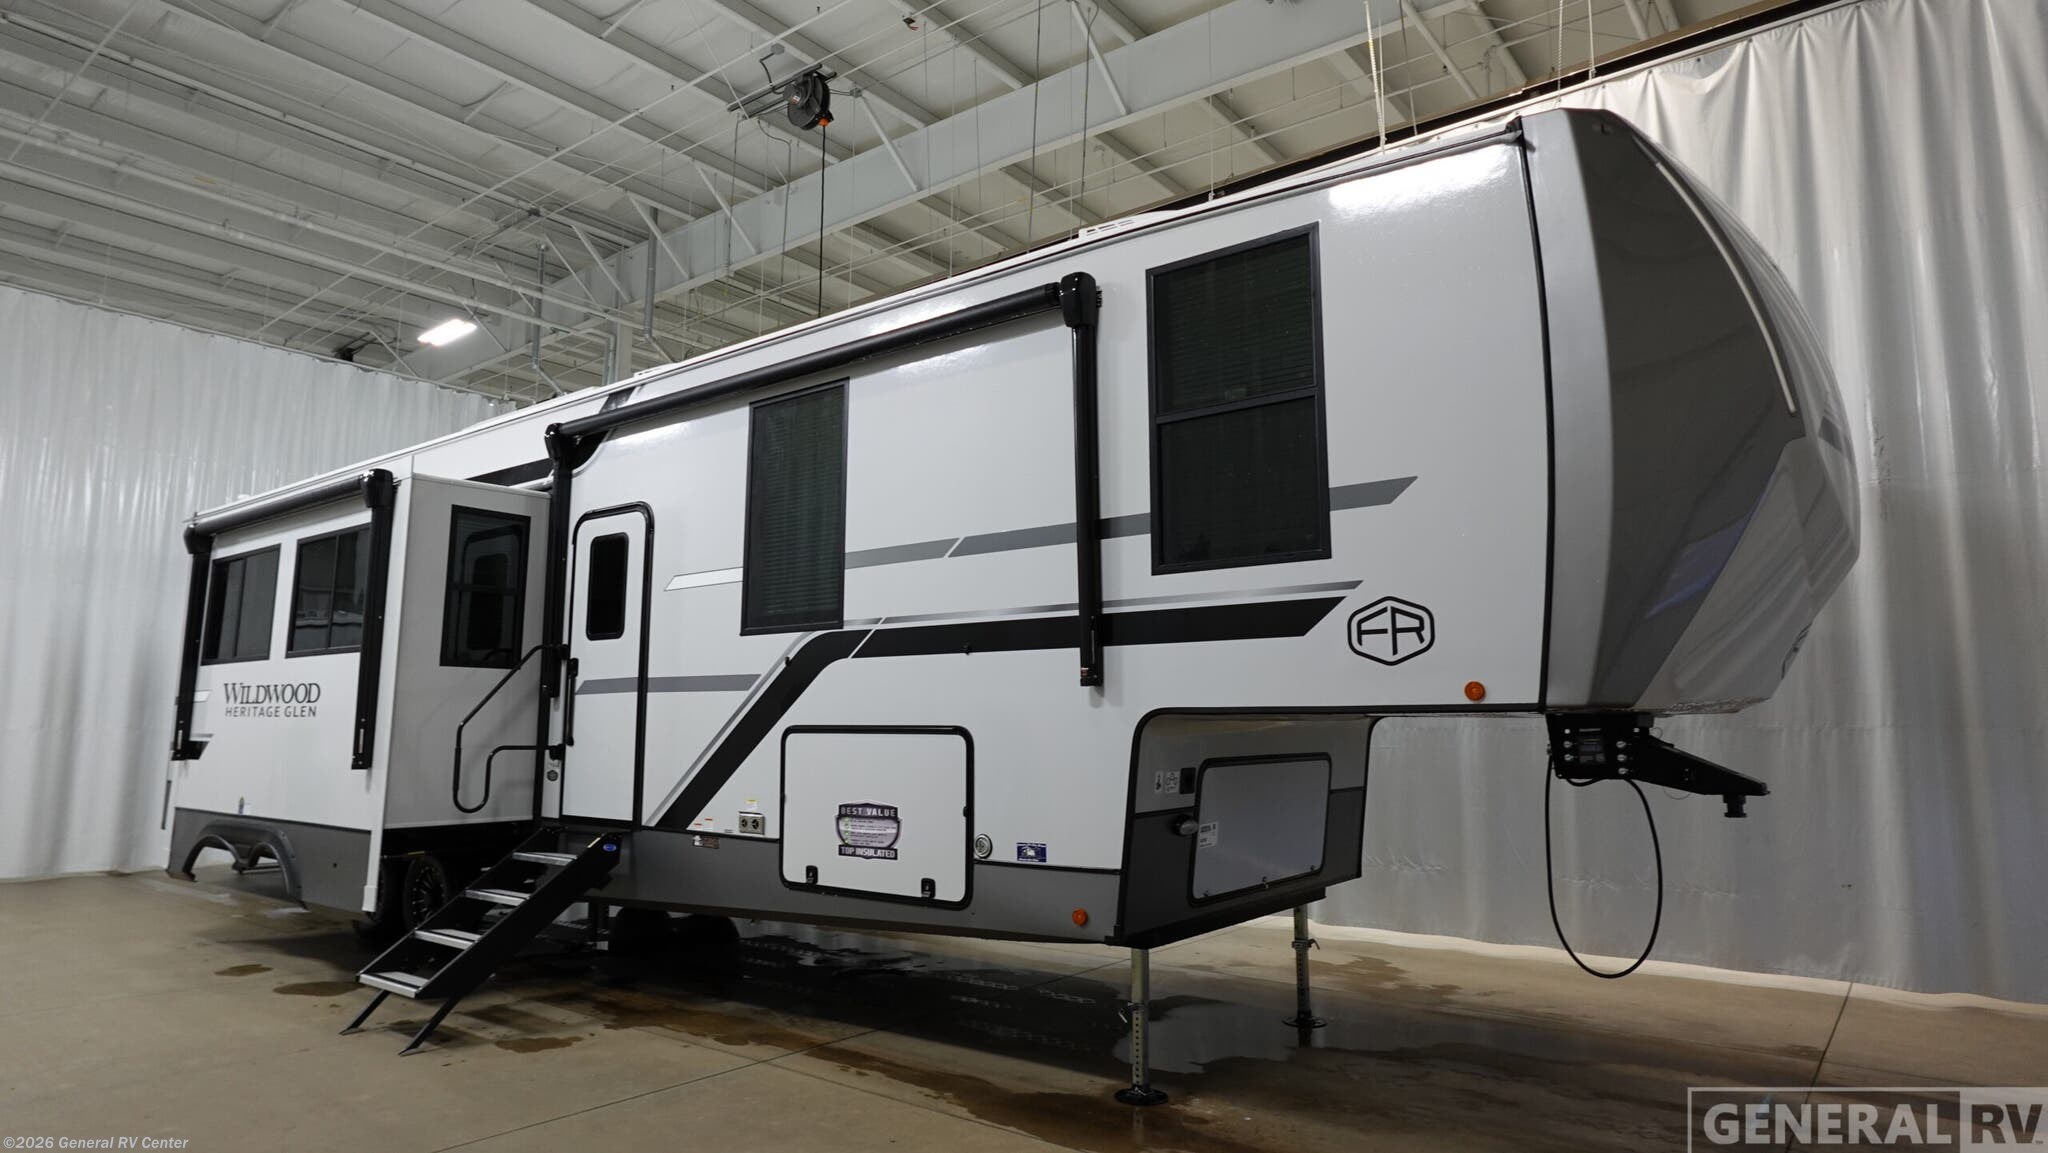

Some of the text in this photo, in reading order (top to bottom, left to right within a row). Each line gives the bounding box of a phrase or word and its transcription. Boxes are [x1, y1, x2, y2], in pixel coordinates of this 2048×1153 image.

[223, 682, 321, 704] WILDWOOD
[224, 705, 317, 718] HERITAGE GLEN
[840, 807, 897, 817] BEST VALUE
[841, 847, 895, 858] TOP INSULATED
